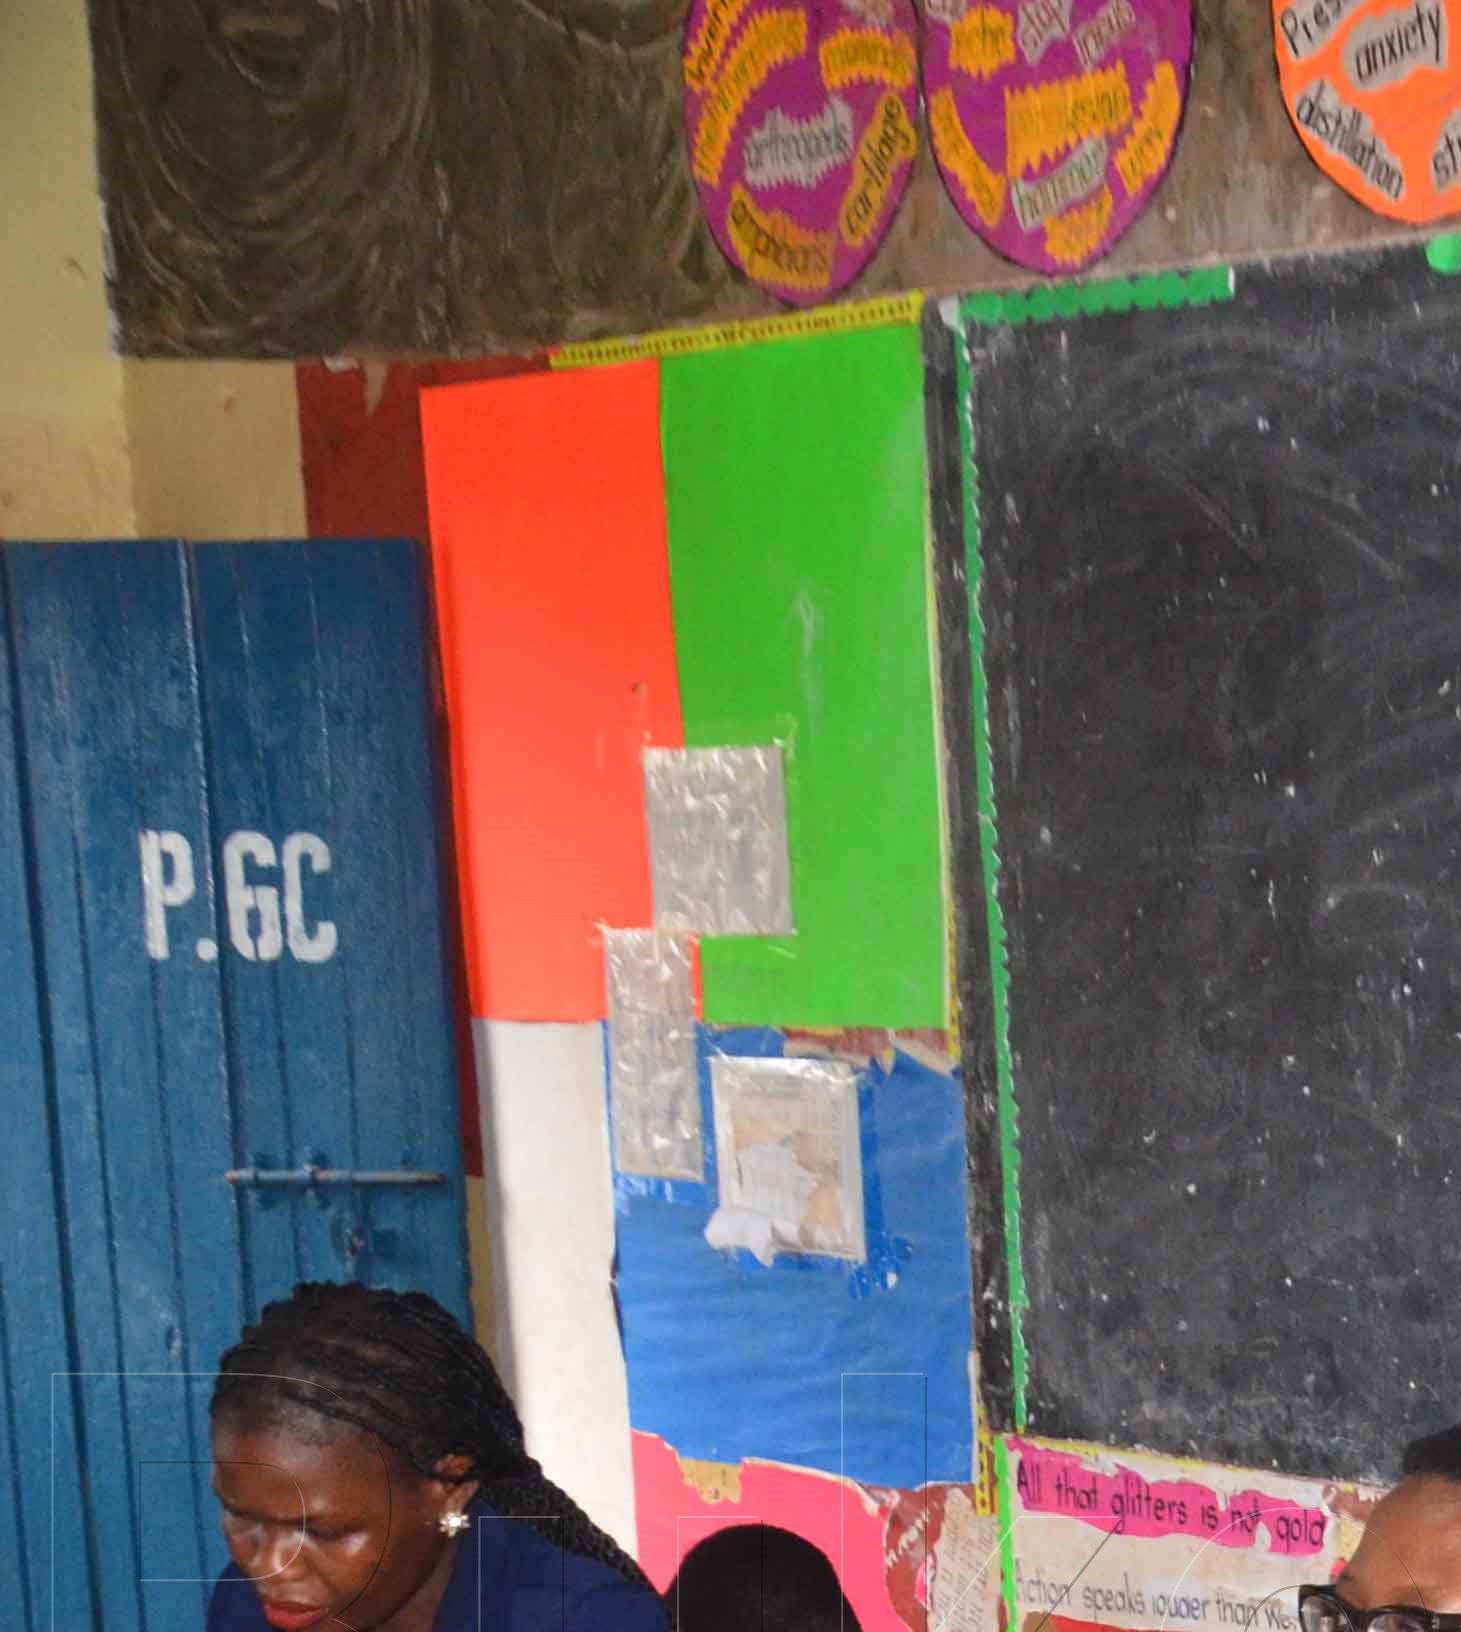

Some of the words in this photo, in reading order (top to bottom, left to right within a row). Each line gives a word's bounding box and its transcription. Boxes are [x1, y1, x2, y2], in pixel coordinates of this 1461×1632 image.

[1354, 2, 1442, 82] anxiety
[1297, 78, 1402, 200] distillation
[1016, 1457, 1042, 1504] All
[1055, 1472, 1100, 1513] that
[1110, 1472, 1188, 1535] glitters
[1200, 1500, 1220, 1532] is
[1276, 1510, 1325, 1554] gold
[1082, 1572, 1146, 1622] speaks
[1216, 1584, 1259, 1629] than
